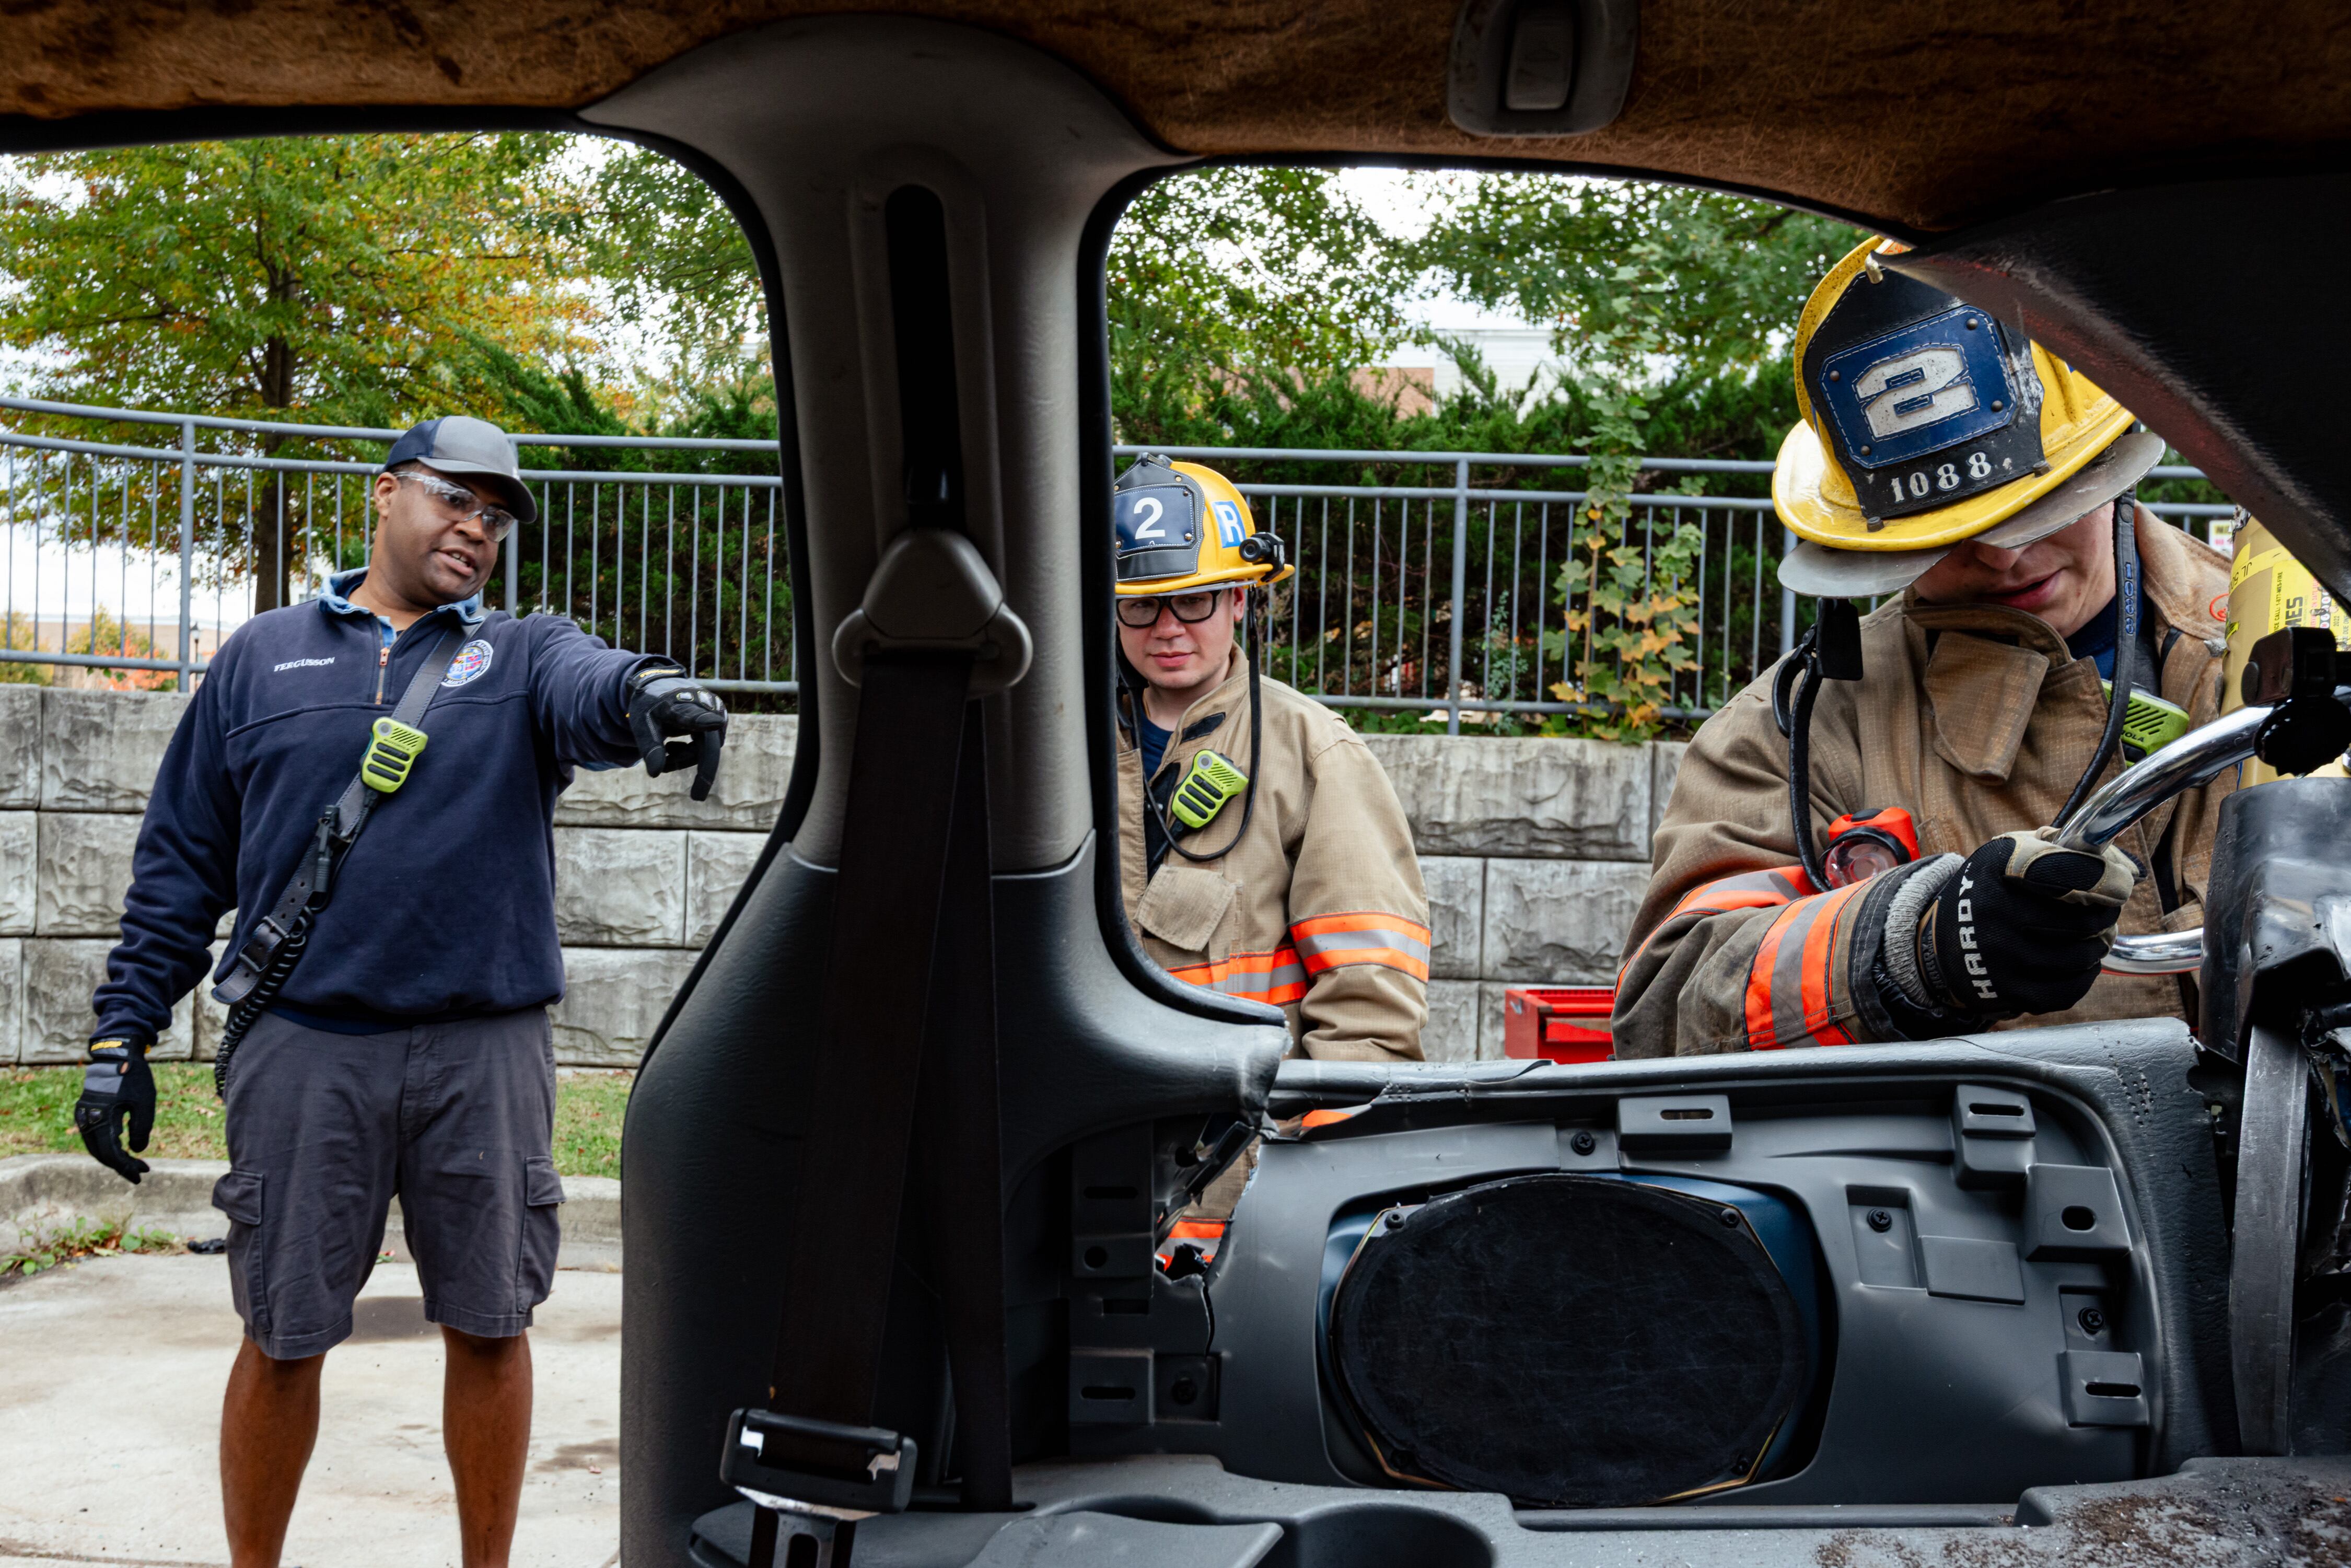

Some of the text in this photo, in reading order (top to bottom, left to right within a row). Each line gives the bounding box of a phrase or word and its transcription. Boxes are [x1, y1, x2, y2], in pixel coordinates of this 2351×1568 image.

[1856, 347, 1976, 438] 2
[1890, 451, 1992, 503] 1088
[1133, 497, 1166, 540] 2
[1215, 504, 1244, 542] R
[2124, 562, 2135, 635] 1088
[273, 656, 335, 672] FERGUSSON
[1201, 771, 1224, 790] MOTOROLA
[1958, 875, 1998, 998] HARDY
